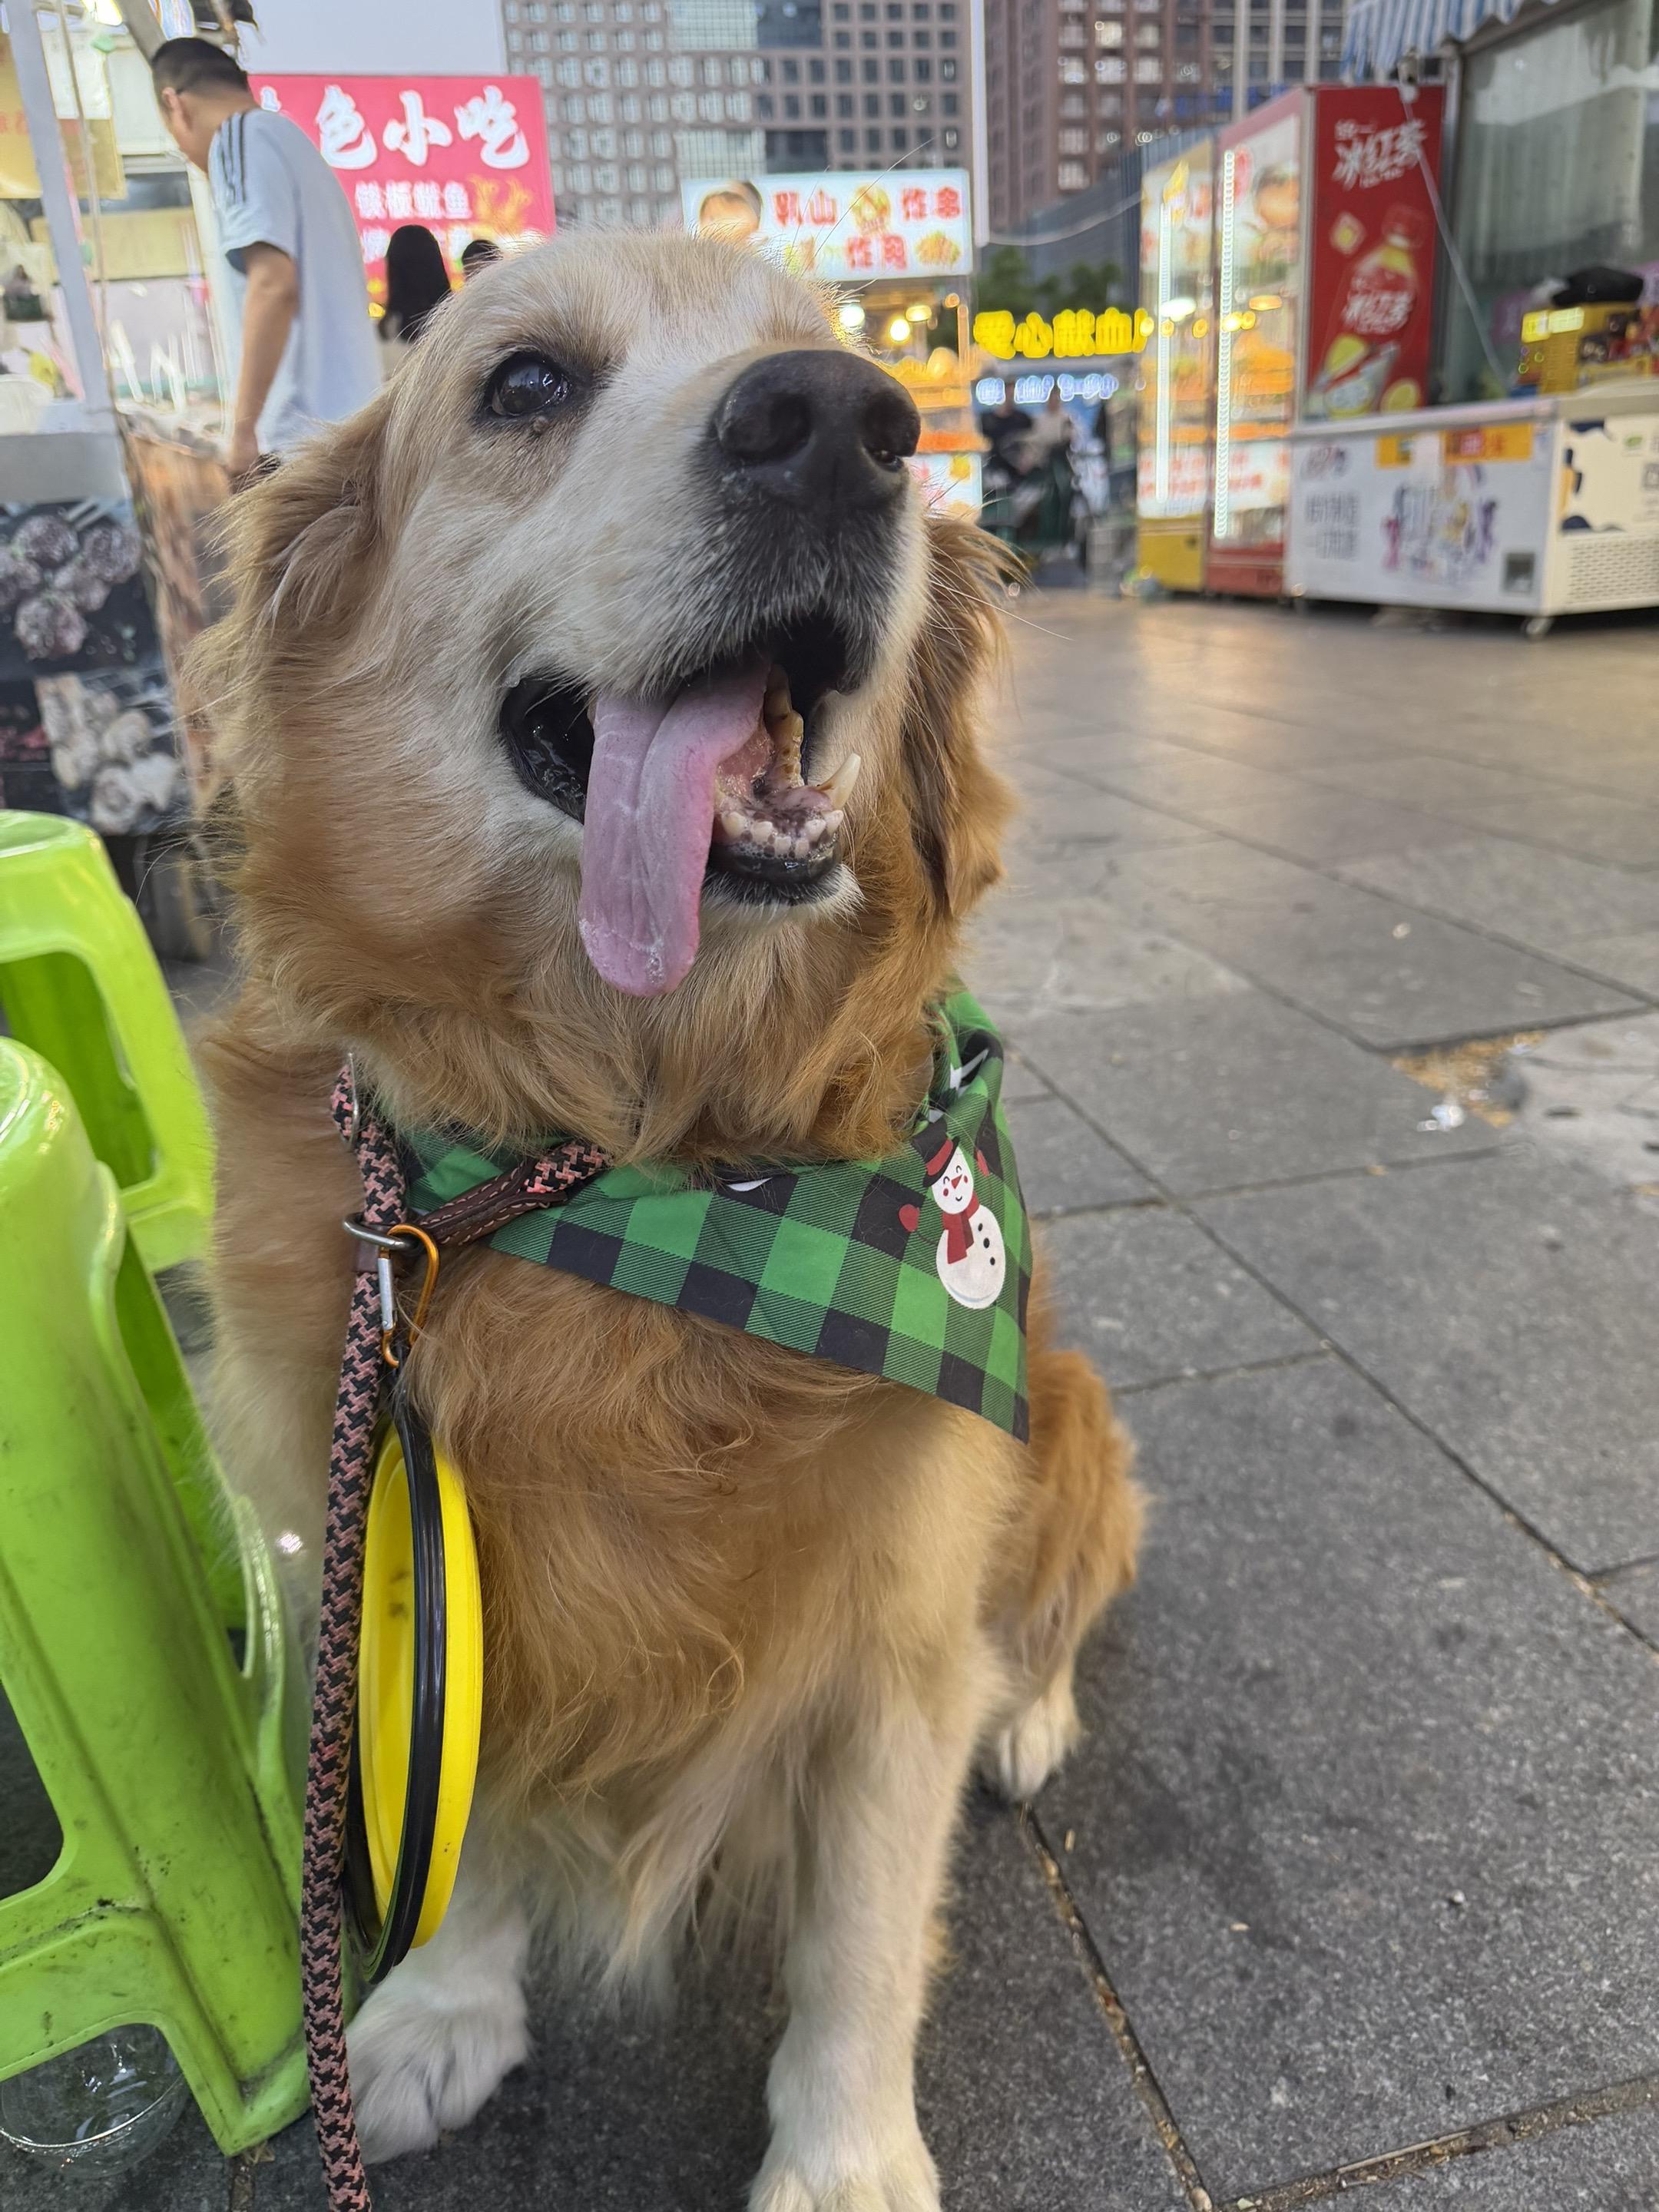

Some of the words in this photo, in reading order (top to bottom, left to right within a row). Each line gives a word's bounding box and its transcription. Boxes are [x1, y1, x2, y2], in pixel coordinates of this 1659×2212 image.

[260, 85, 530, 170] 色小吃
[1332, 120, 1426, 190] 冰红茶
